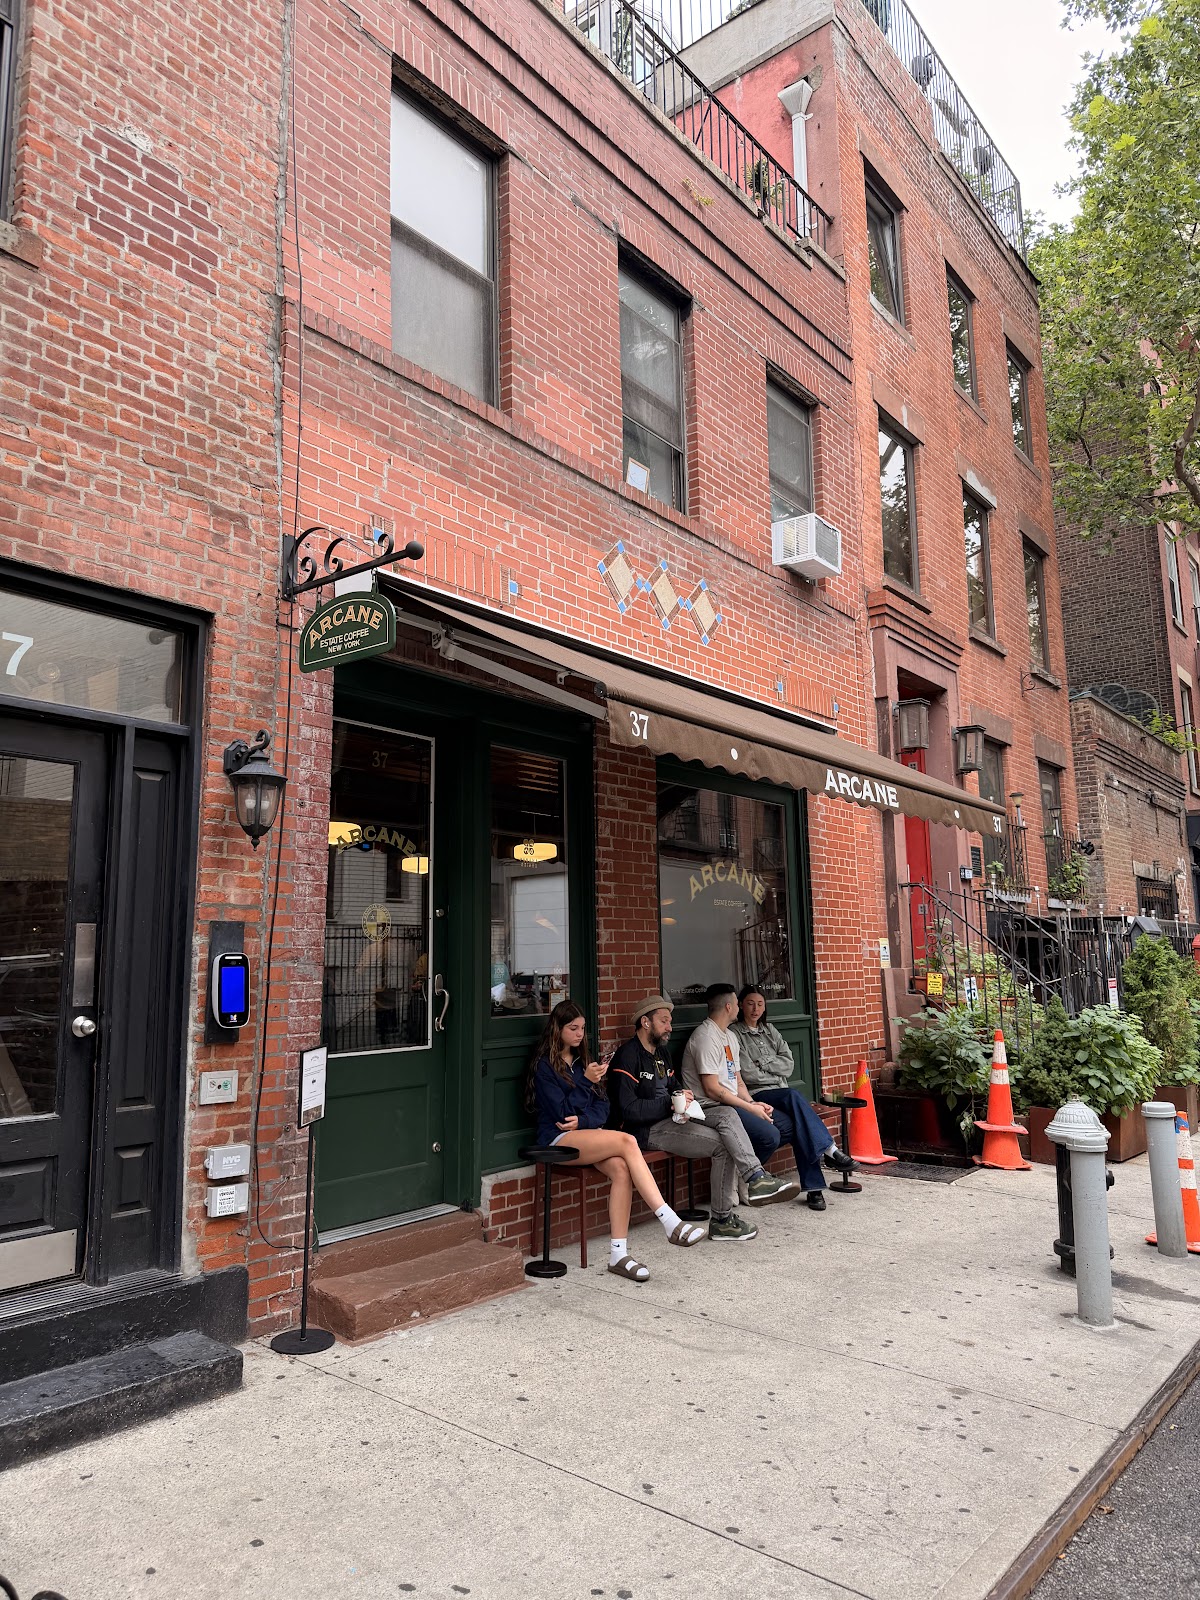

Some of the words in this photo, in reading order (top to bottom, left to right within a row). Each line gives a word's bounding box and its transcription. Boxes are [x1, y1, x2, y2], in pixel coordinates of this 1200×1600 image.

[309, 605, 384, 650] ARCANE
[320, 634, 344, 648] ESTATE
[343, 627, 370, 642] COFFEE
[2, 631, 34, 676] 7
[327, 643, 343, 654] NEW
[344, 639, 361, 650] YORK
[629, 711, 649, 740] 37
[372, 750, 389, 769] 37
[824, 768, 900, 808] ARCANE
[992, 815, 1002, 833] 37
[337, 825, 417, 858] ARCANE
[689, 861, 766, 905] ARCANE
[222, 1155, 241, 1165] NYC
